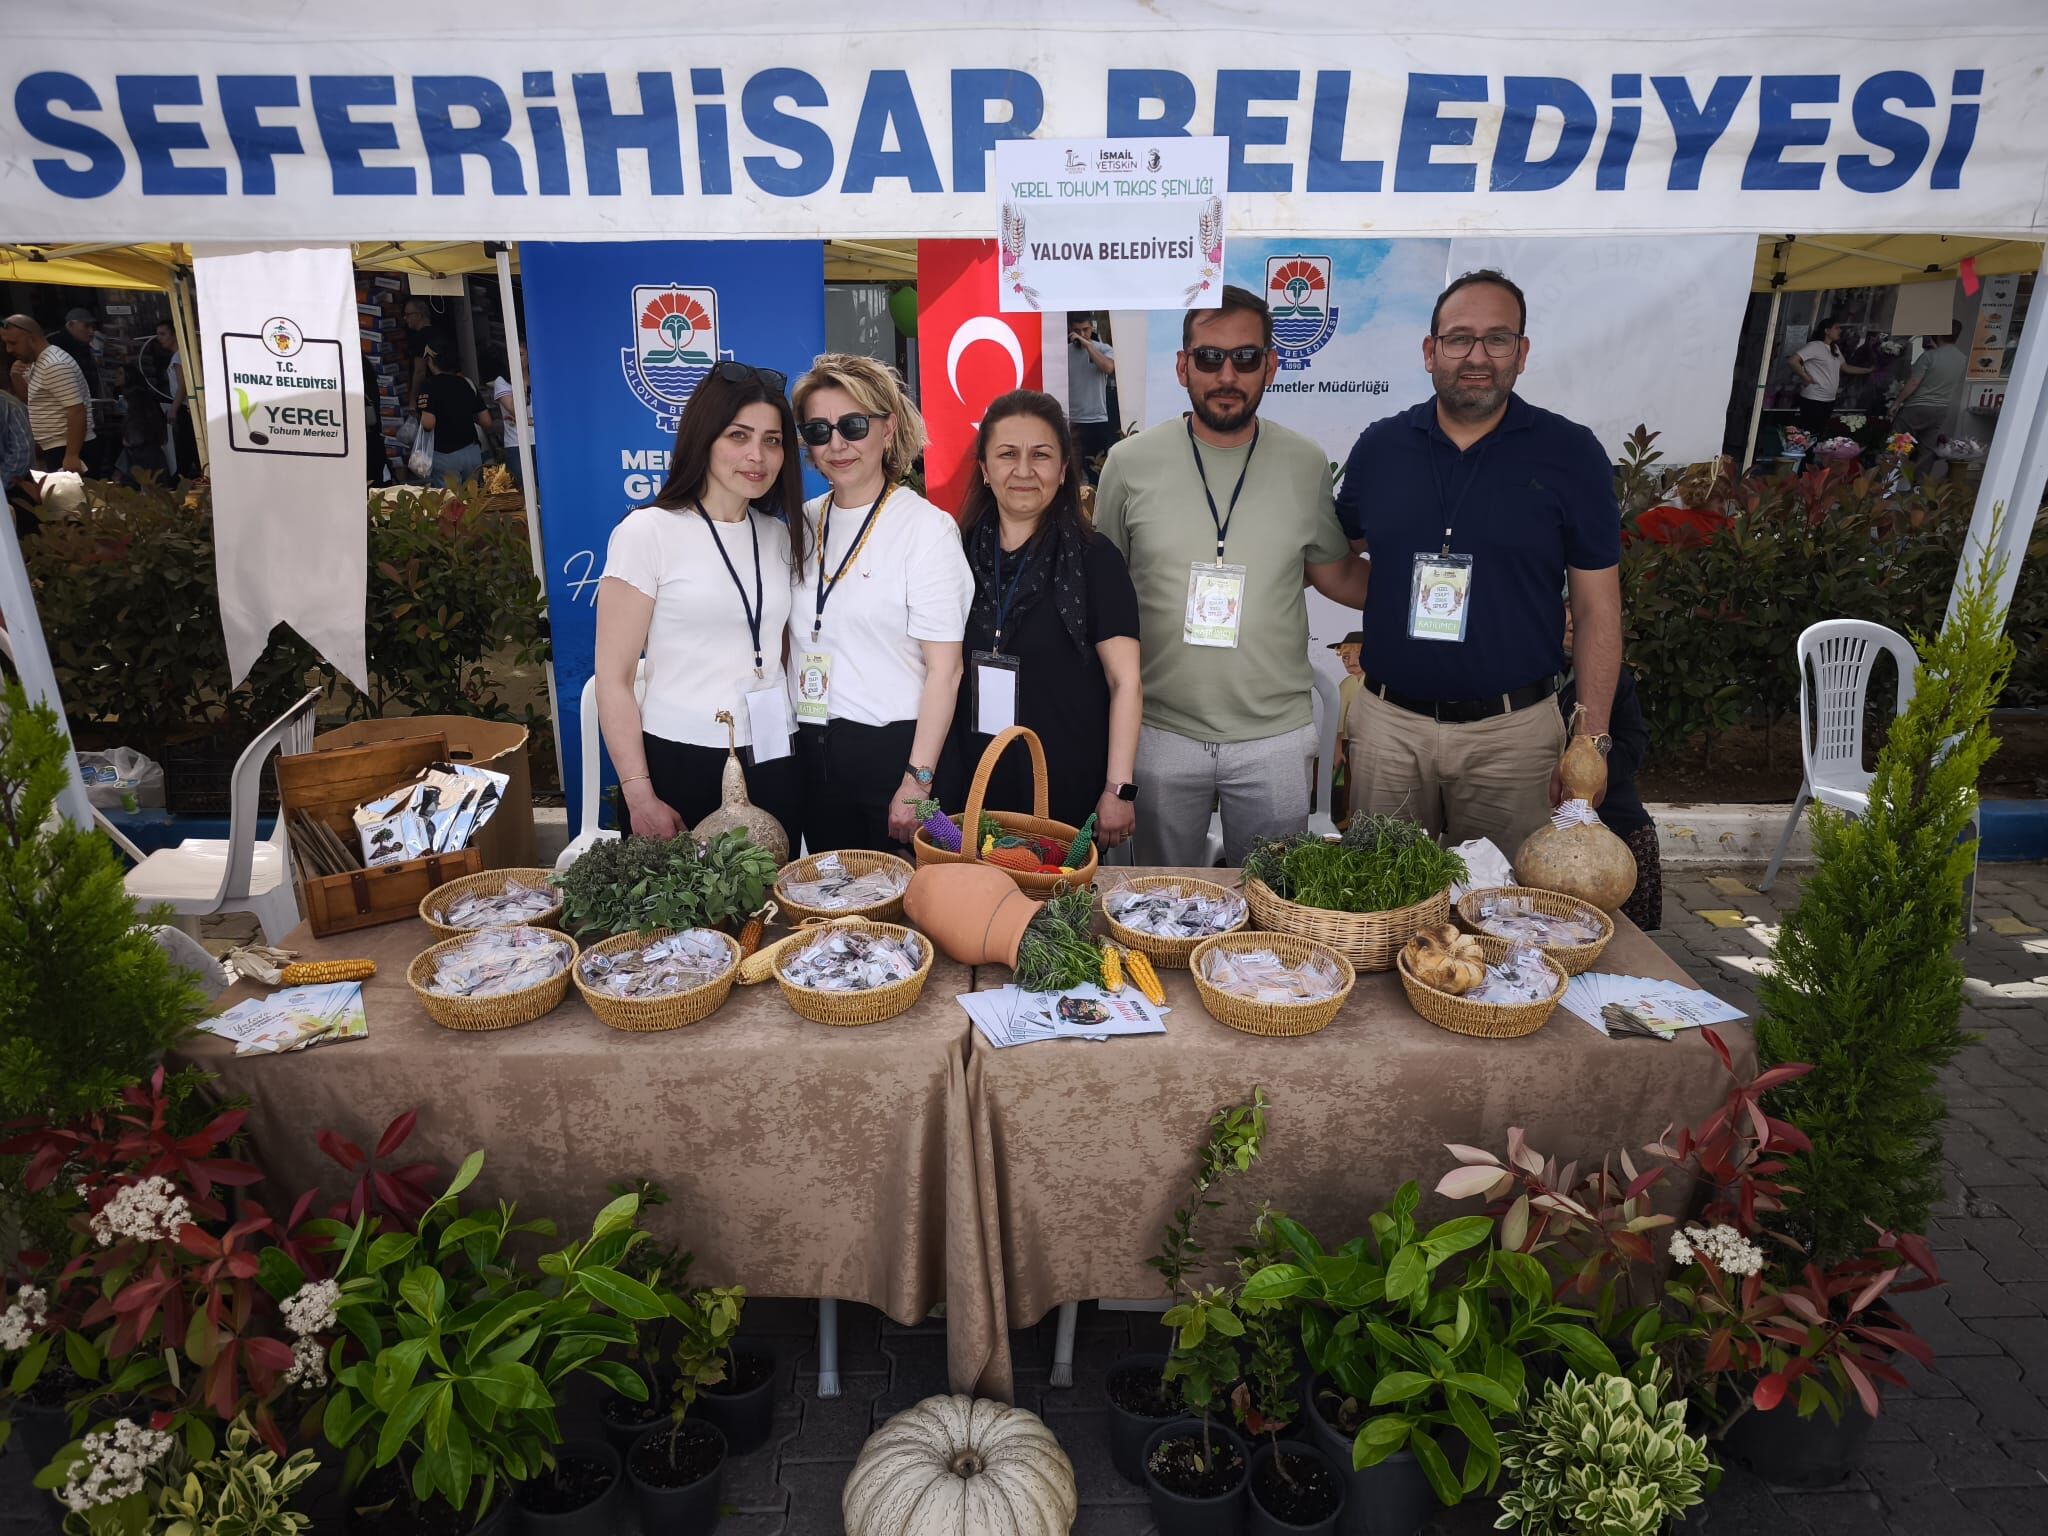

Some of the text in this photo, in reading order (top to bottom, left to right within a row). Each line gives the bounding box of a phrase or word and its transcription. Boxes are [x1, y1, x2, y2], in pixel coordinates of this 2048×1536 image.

[1099, 149, 1134, 161] İSMAİL
[1011, 176, 1214, 198] YEREL TOHUM TAKAS ŞENLİĞİ
[1031, 236, 1194, 261] YALOVA BELEDİYESİ
[276, 361, 298, 373] T.C.
[234, 373, 338, 390] HONAZ BELEDİYESİ
[1318, 380, 1389, 395] Müdürlüğü
[264, 406, 341, 427] YEREL
[268, 426, 339, 438] Tohum Merkezi
